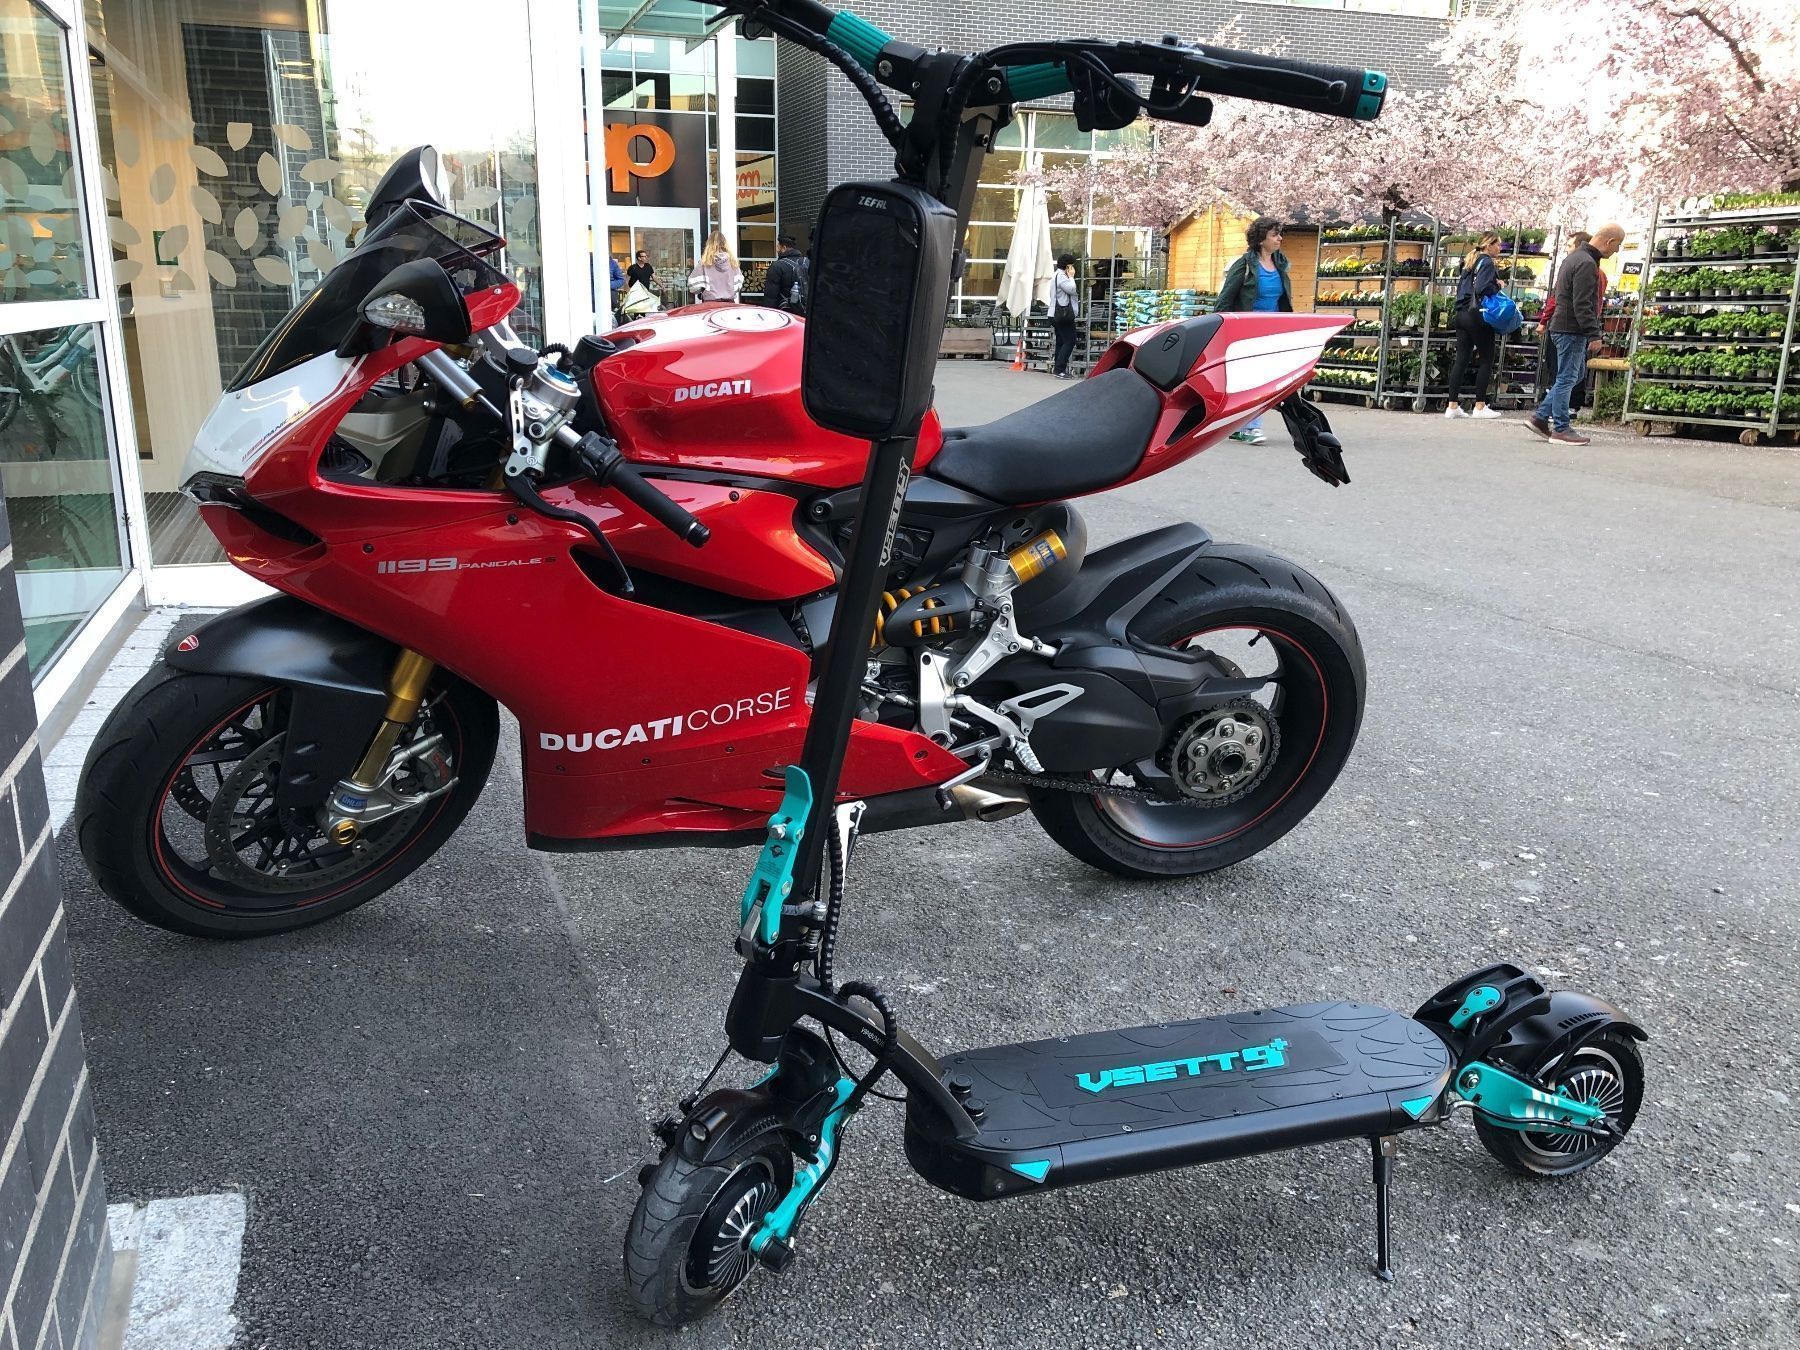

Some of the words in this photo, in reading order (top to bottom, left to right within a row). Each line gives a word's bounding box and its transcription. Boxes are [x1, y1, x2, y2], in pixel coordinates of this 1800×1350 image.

[858, 196, 887, 209] ZEFAL
[674, 379, 751, 403] DUCATI
[378, 557, 458, 574] 1199
[458, 558, 543, 570] PANIGALE
[539, 715, 683, 753] DUCATI
[687, 687, 791, 731] CORSE
